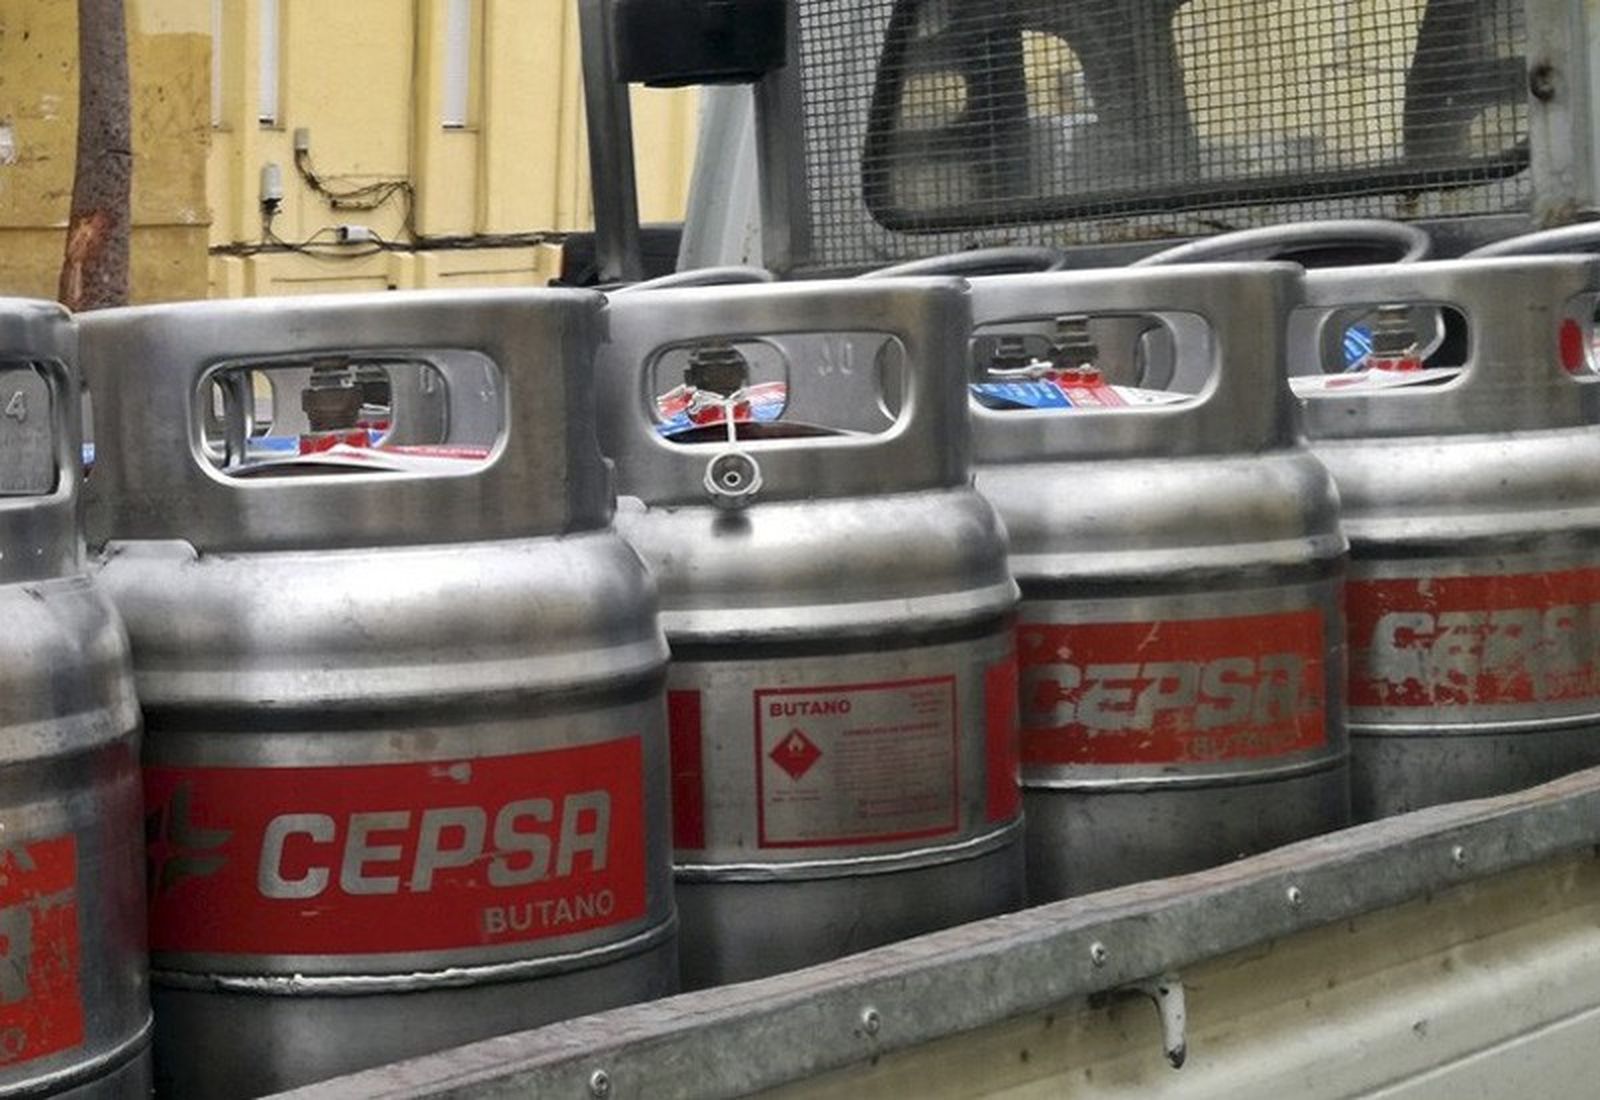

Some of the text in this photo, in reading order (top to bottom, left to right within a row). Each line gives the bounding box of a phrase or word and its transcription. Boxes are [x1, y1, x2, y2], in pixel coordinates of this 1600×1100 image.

[1369, 603, 1600, 684] CEPS
[769, 699, 852, 717] BUTANO
[1020, 653, 1305, 731] CEPSA
[257, 789, 611, 899] CEPSA
[484, 890, 615, 934] BUTANO
